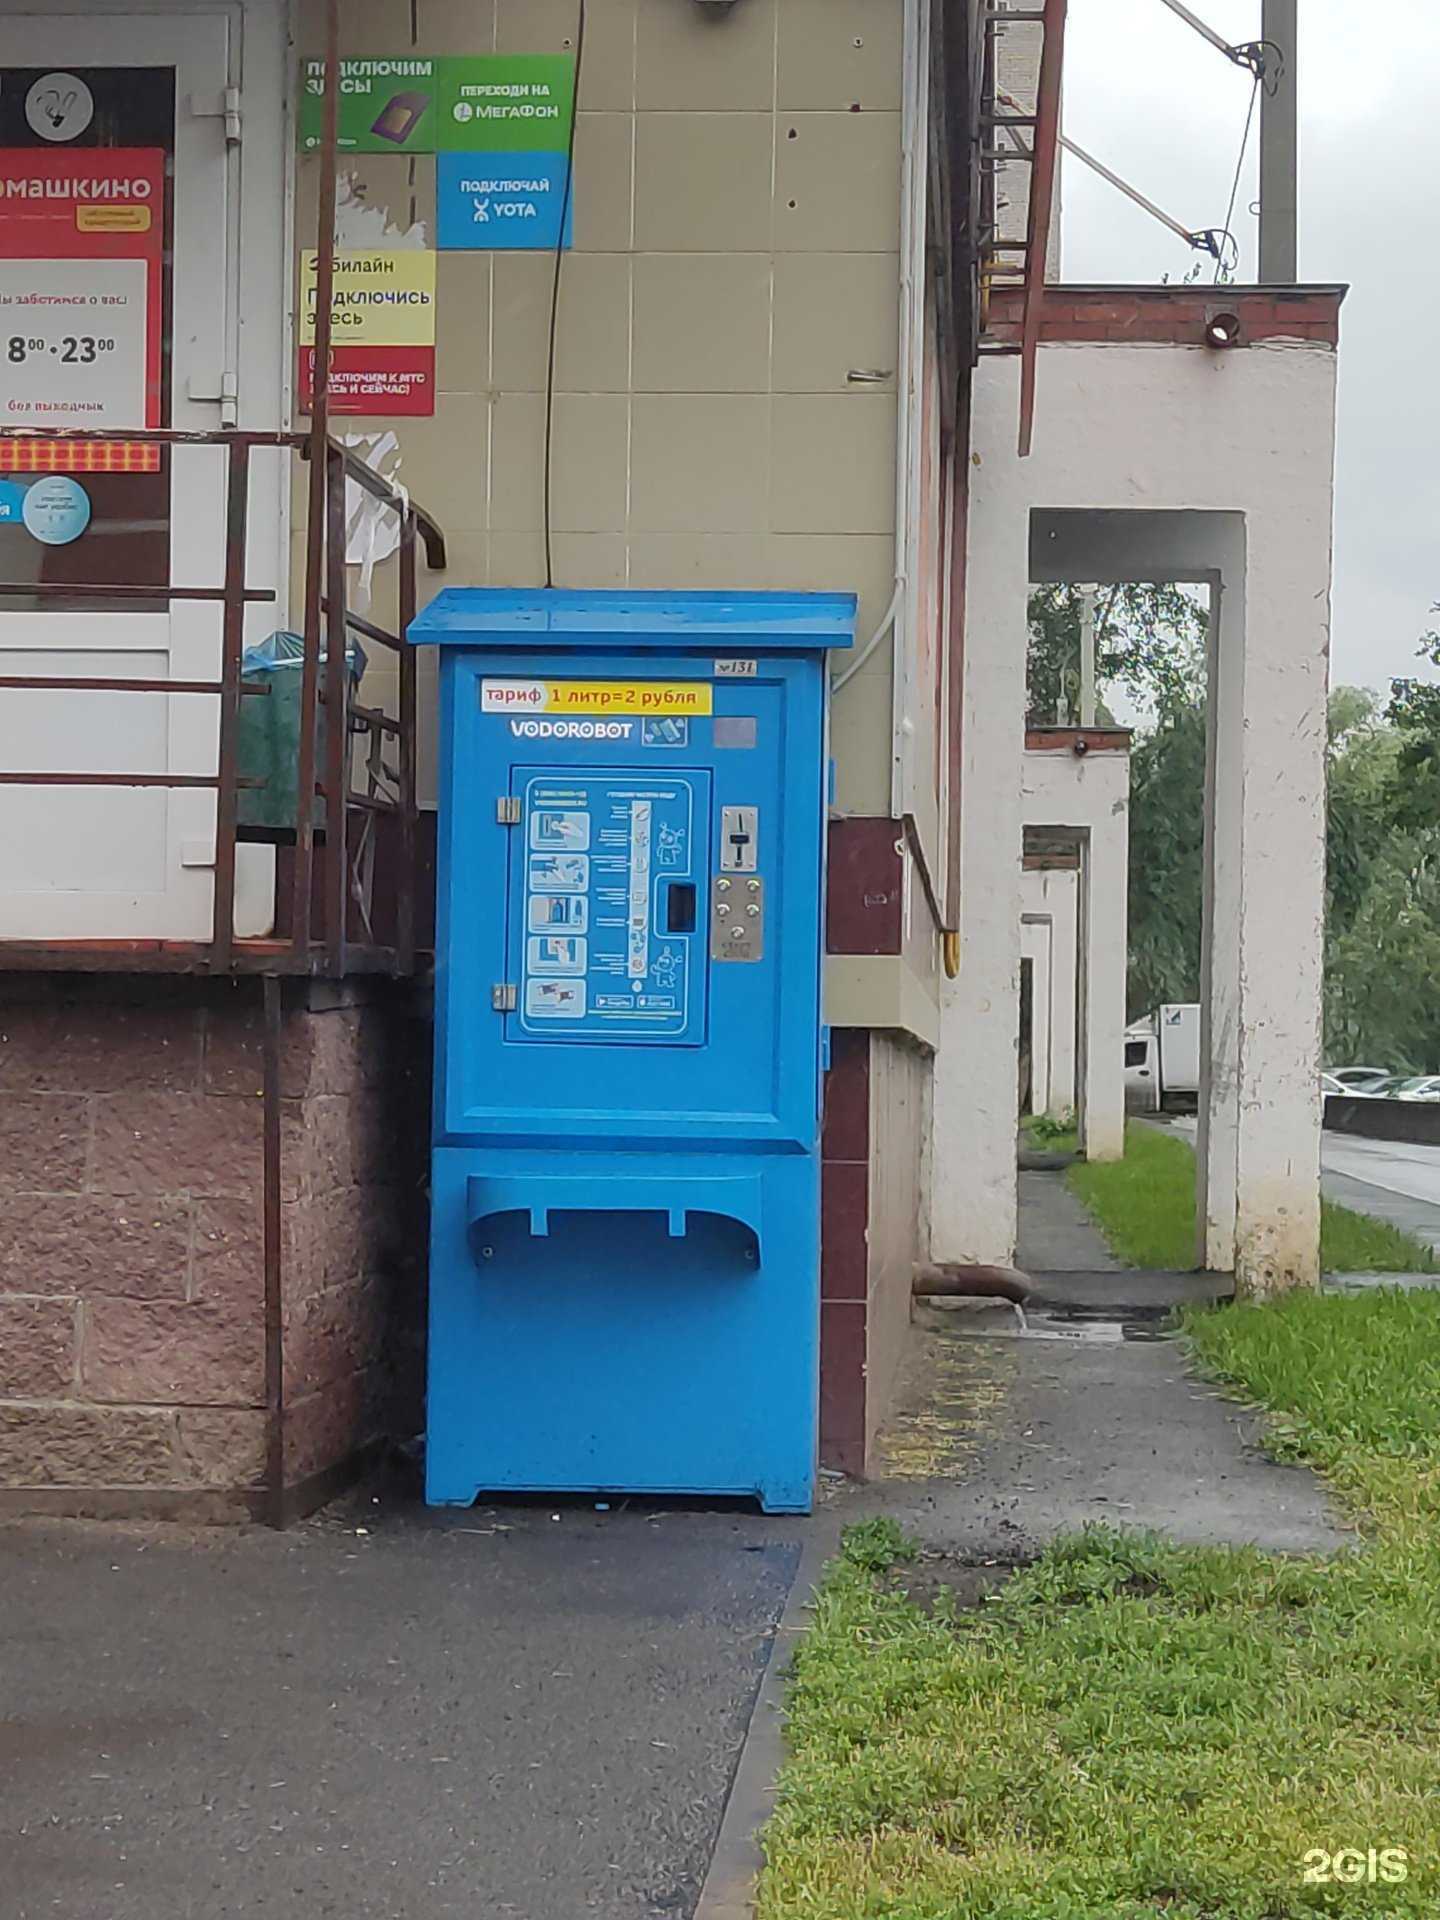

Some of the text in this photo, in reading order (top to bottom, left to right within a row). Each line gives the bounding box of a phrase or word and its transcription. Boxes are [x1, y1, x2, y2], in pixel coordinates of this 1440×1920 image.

[460, 85, 550, 97] ПЕРЕХОДИ НА
[0, 178, 151, 198] машкино
[460, 179, 550, 193] ПОДКЛЮЧАЙ
[493, 203, 536, 217] YOTA
[307, 287, 430, 307] Пдключись
[306, 312, 363, 325] зесь
[486, 687, 542, 704] тариф
[552, 689, 560, 702] 1
[641, 689, 697, 707] рубля
[510, 719, 633, 739] VODOROBOT
